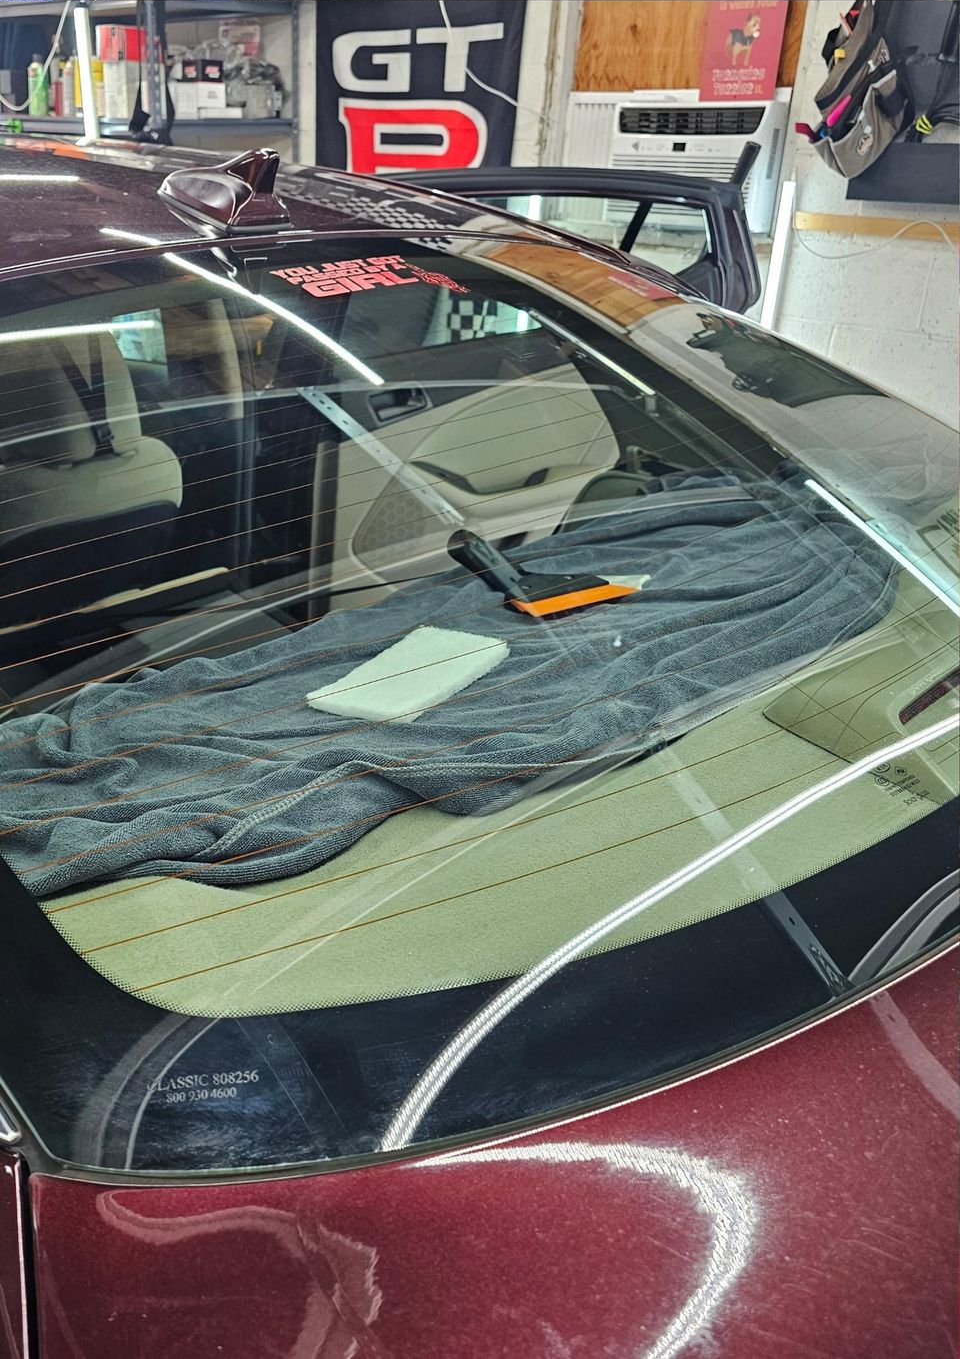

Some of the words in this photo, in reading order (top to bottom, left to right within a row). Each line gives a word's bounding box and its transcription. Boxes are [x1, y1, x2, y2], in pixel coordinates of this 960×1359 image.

[332, 22, 504, 92] GT
[269, 266, 319, 279] YOU
[321, 258, 369, 272] JUST
[366, 254, 407, 265] GOT
[286, 268, 367, 285] PASSED
[362, 265, 390, 274] BY
[301, 271, 419, 298] GIRL
[146, 1074, 209, 1092] CLASSIC
[212, 1070, 260, 1085] 808256
[166, 1092, 187, 1103] 800
[210, 1087, 237, 1098] 4600
